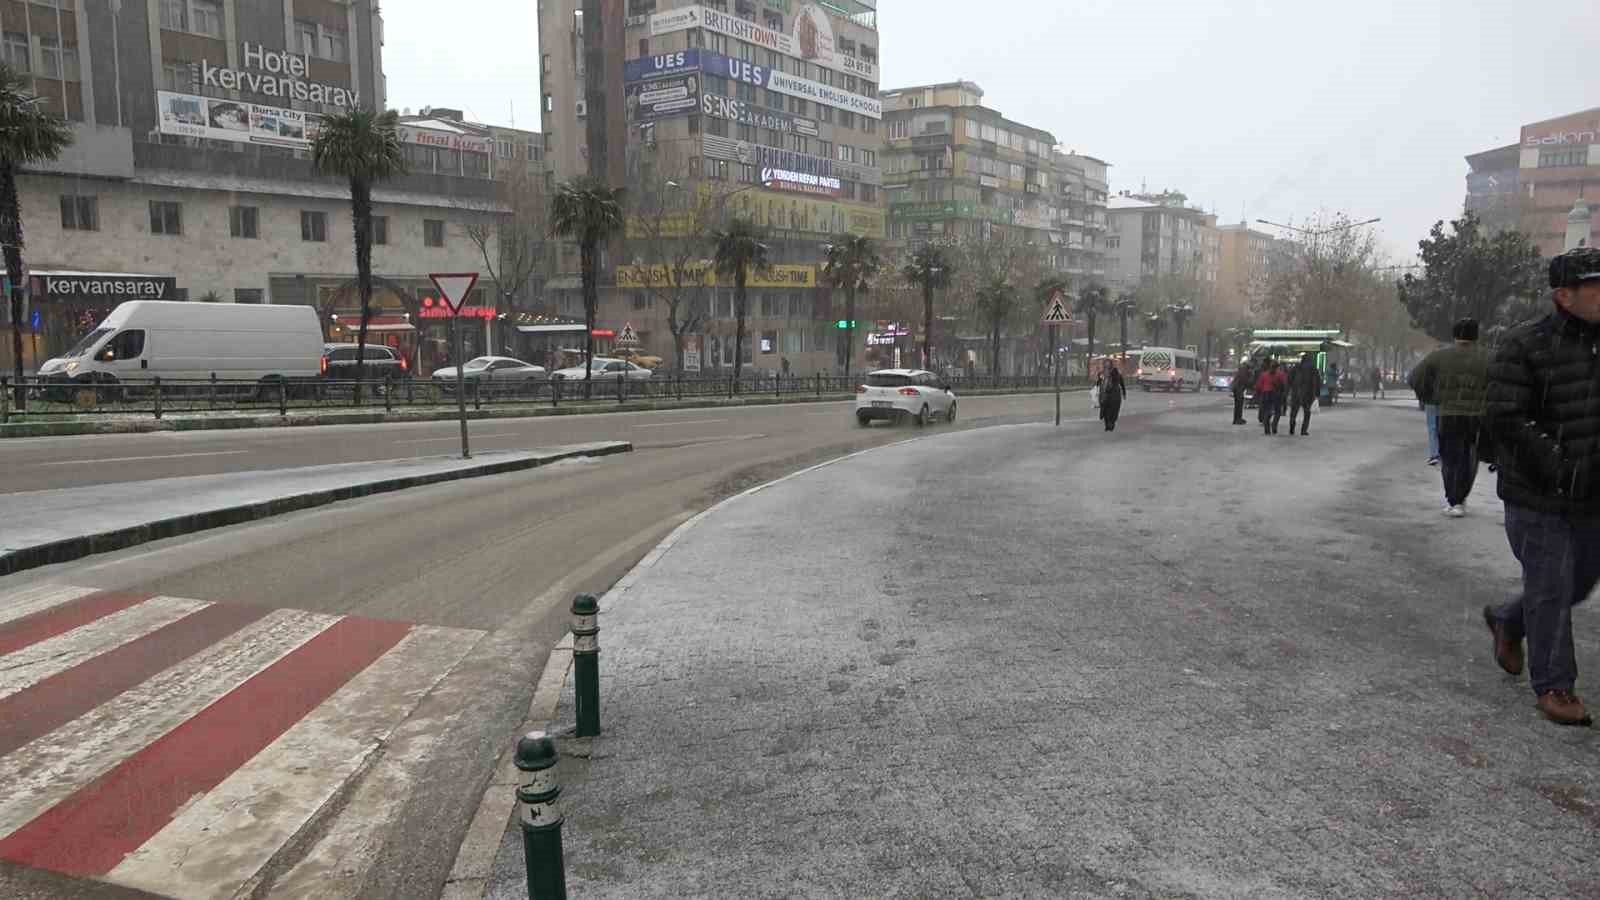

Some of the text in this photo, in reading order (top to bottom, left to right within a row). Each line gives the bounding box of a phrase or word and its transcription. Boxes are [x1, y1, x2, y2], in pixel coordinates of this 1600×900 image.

[704, 9, 777, 48] BRITISHTOWN
[244, 41, 311, 78] Hotel
[655, 52, 685, 69] UES
[202, 59, 360, 112] kervansaray
[729, 58, 881, 114] UES UNIVERSAL ENGLISH SCHOOLS
[282, 110, 302, 121] City
[703, 94, 745, 122] SENSE
[47, 277, 166, 299] kervansaray
